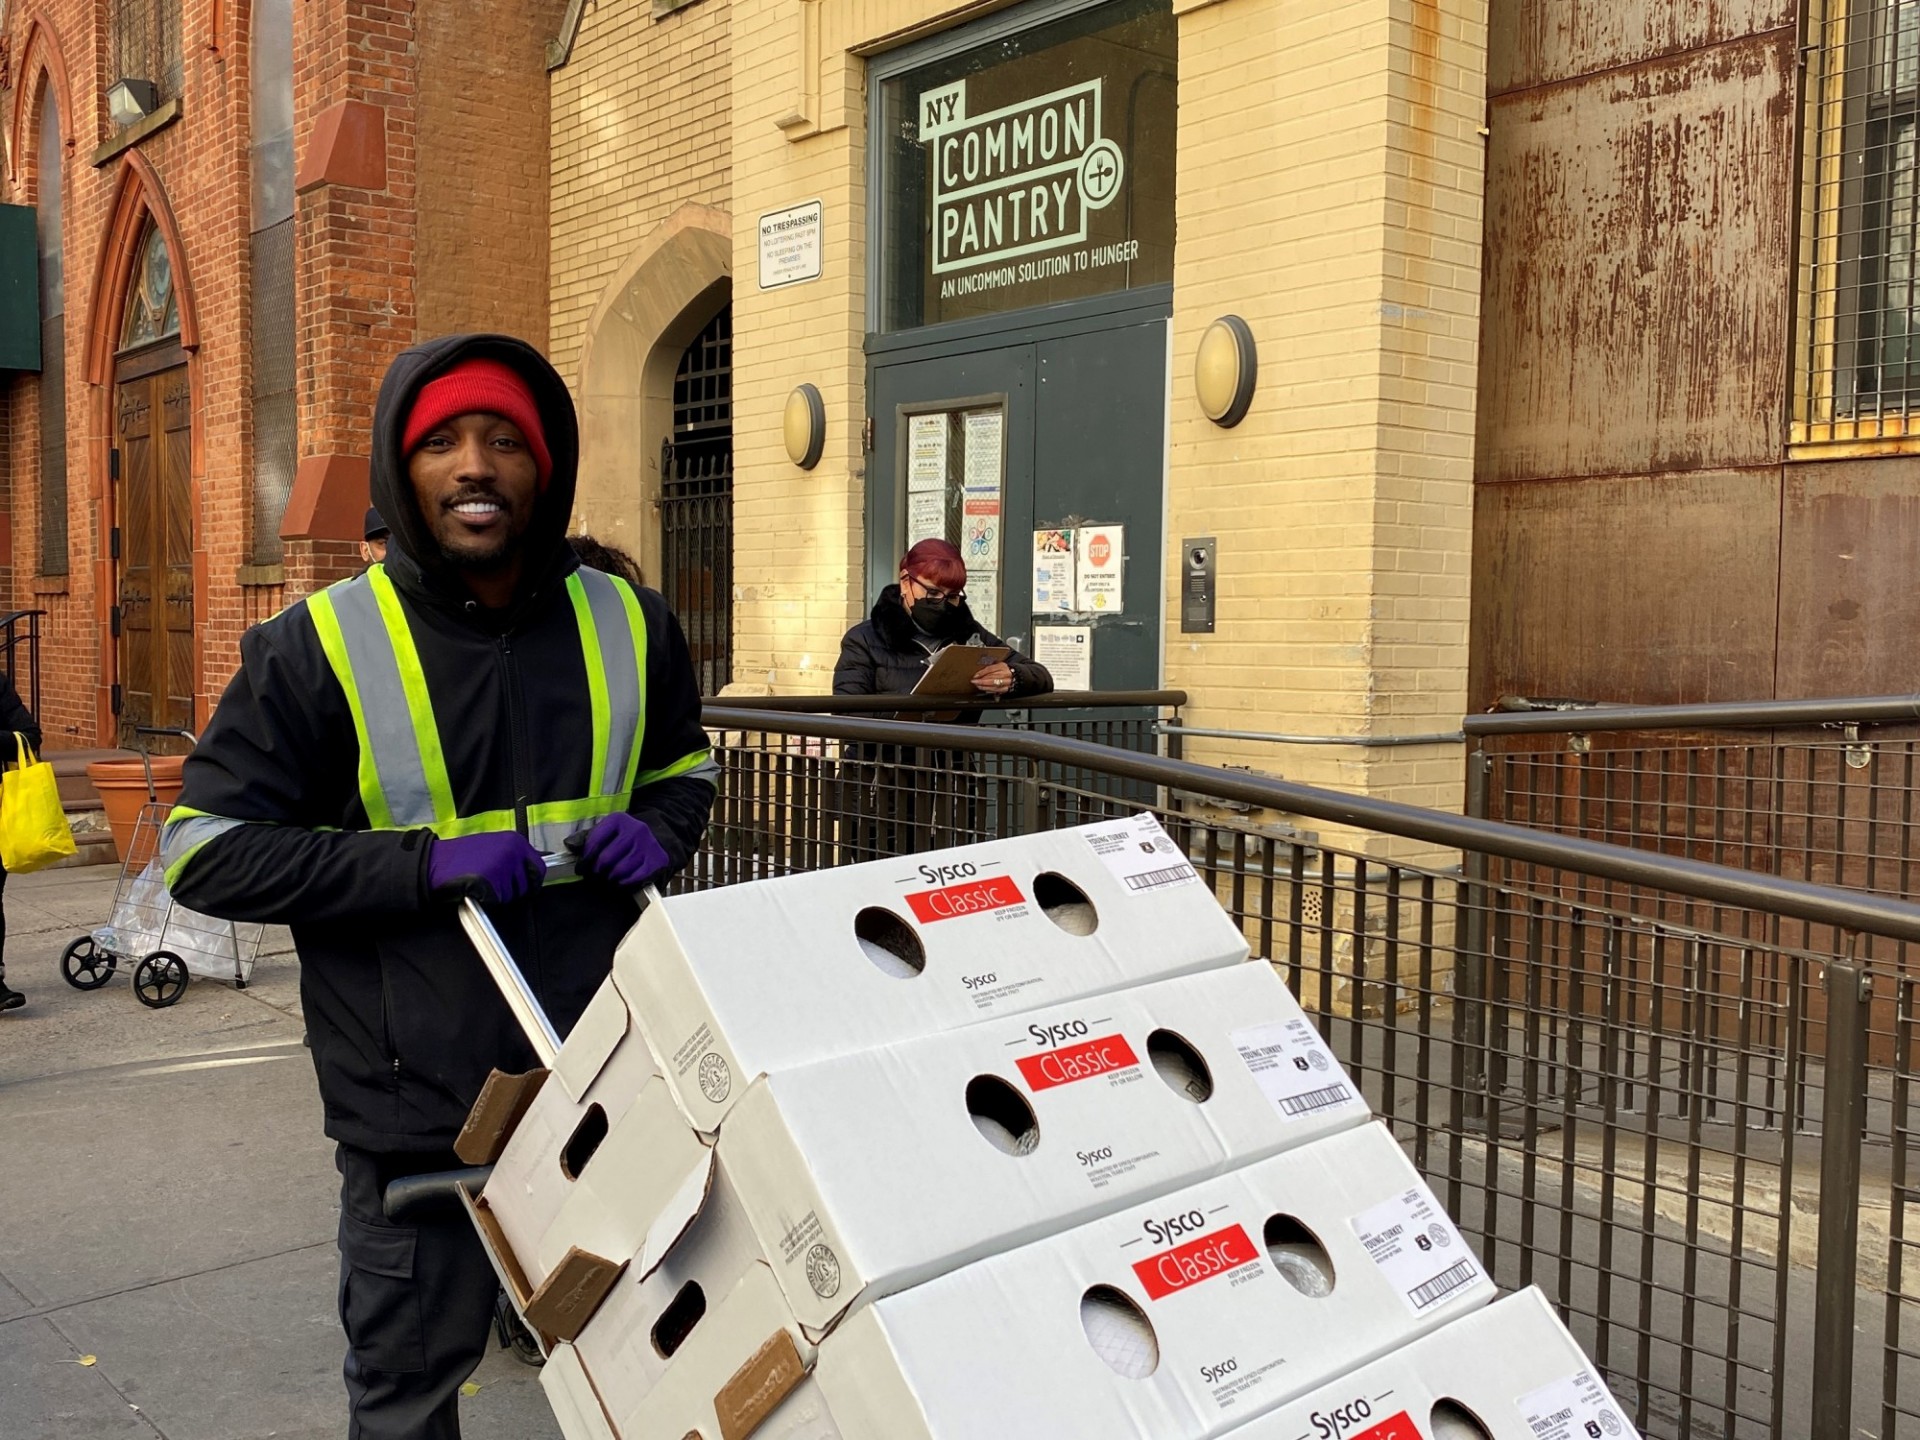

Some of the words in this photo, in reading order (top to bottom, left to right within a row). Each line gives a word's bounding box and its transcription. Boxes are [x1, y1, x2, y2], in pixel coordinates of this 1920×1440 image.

[926, 92, 959, 128] NY
[943, 98, 1086, 186] COMMON
[762, 225, 771, 235] NO
[773, 212, 818, 232] TRESPASSING
[943, 178, 1072, 258] PANTRY
[941, 280, 955, 299] AN
[958, 265, 1016, 294] UNCOMMON
[1018, 254, 1070, 282] SOLUTION
[1074, 251, 1088, 271] TO
[1091, 239, 1138, 266] HUNGER
[1090, 544, 1109, 558] STOP
[1088, 836, 1109, 845] YOUNG
[1108, 832, 1129, 840] TURKEY
[918, 862, 977, 886] Sysco
[928, 885, 1006, 918] Classic
[962, 973, 997, 990] Sysco
[1028, 1020, 1088, 1047] Sysco
[1040, 1045, 1119, 1082] Classic
[1240, 1050, 1262, 1060] YOUNG
[1260, 1045, 1283, 1056] TURKEY
[700, 1055, 725, 1092] INSPECTED
[1076, 1148, 1112, 1167] Sysco
[1144, 1210, 1205, 1246] Sysco
[1363, 1234, 1385, 1250] YOUNG
[1382, 1224, 1404, 1240] TURKEY
[807, 1247, 834, 1286] INSPECTED
[1158, 1239, 1239, 1287] Classic
[1200, 1359, 1237, 1383] Sysco
[1310, 1399, 1371, 1440] Sysco
[1530, 1417, 1553, 1434] YOUNG
[1550, 1407, 1574, 1424] TURKEY
